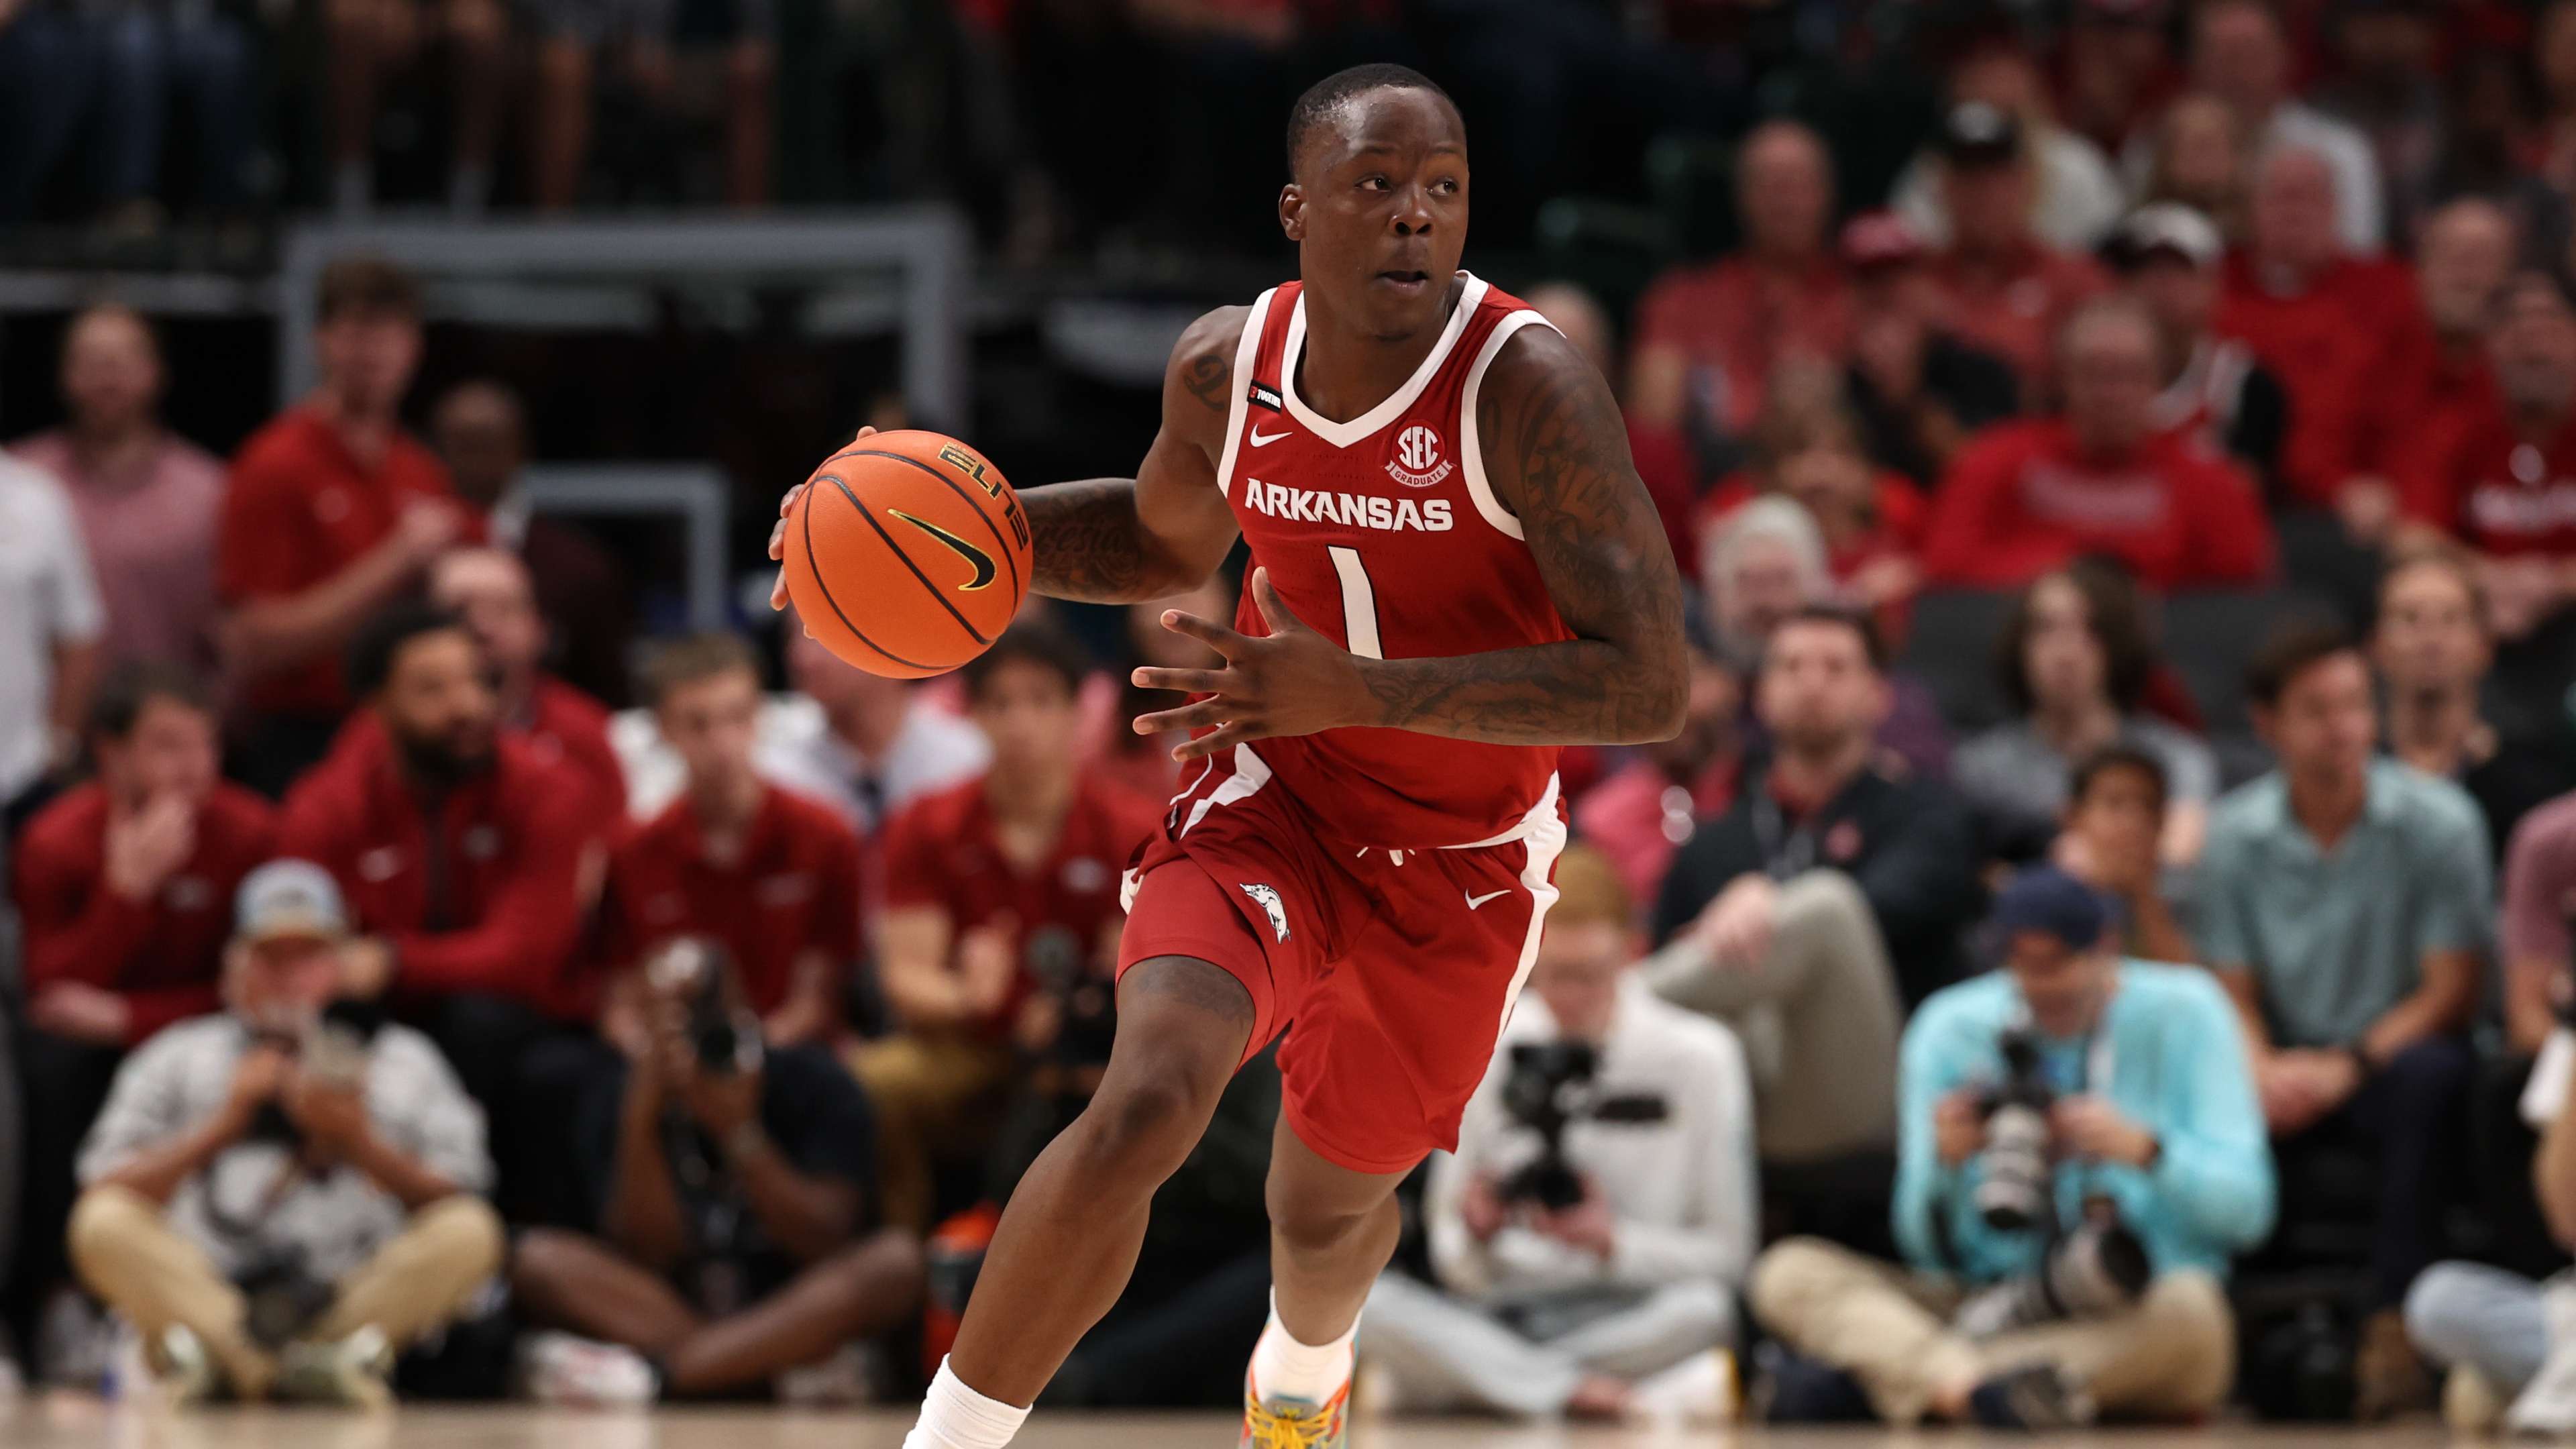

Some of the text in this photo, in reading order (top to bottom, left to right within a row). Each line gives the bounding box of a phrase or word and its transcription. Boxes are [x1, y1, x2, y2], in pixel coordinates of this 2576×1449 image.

[1397, 426, 1438, 470] SEC
[938, 445, 1028, 551] ELITE
[1395, 470, 1444, 485] GRADUATE
[1244, 478, 1454, 532] ARKANSAS
[1328, 545, 1384, 660] 1
